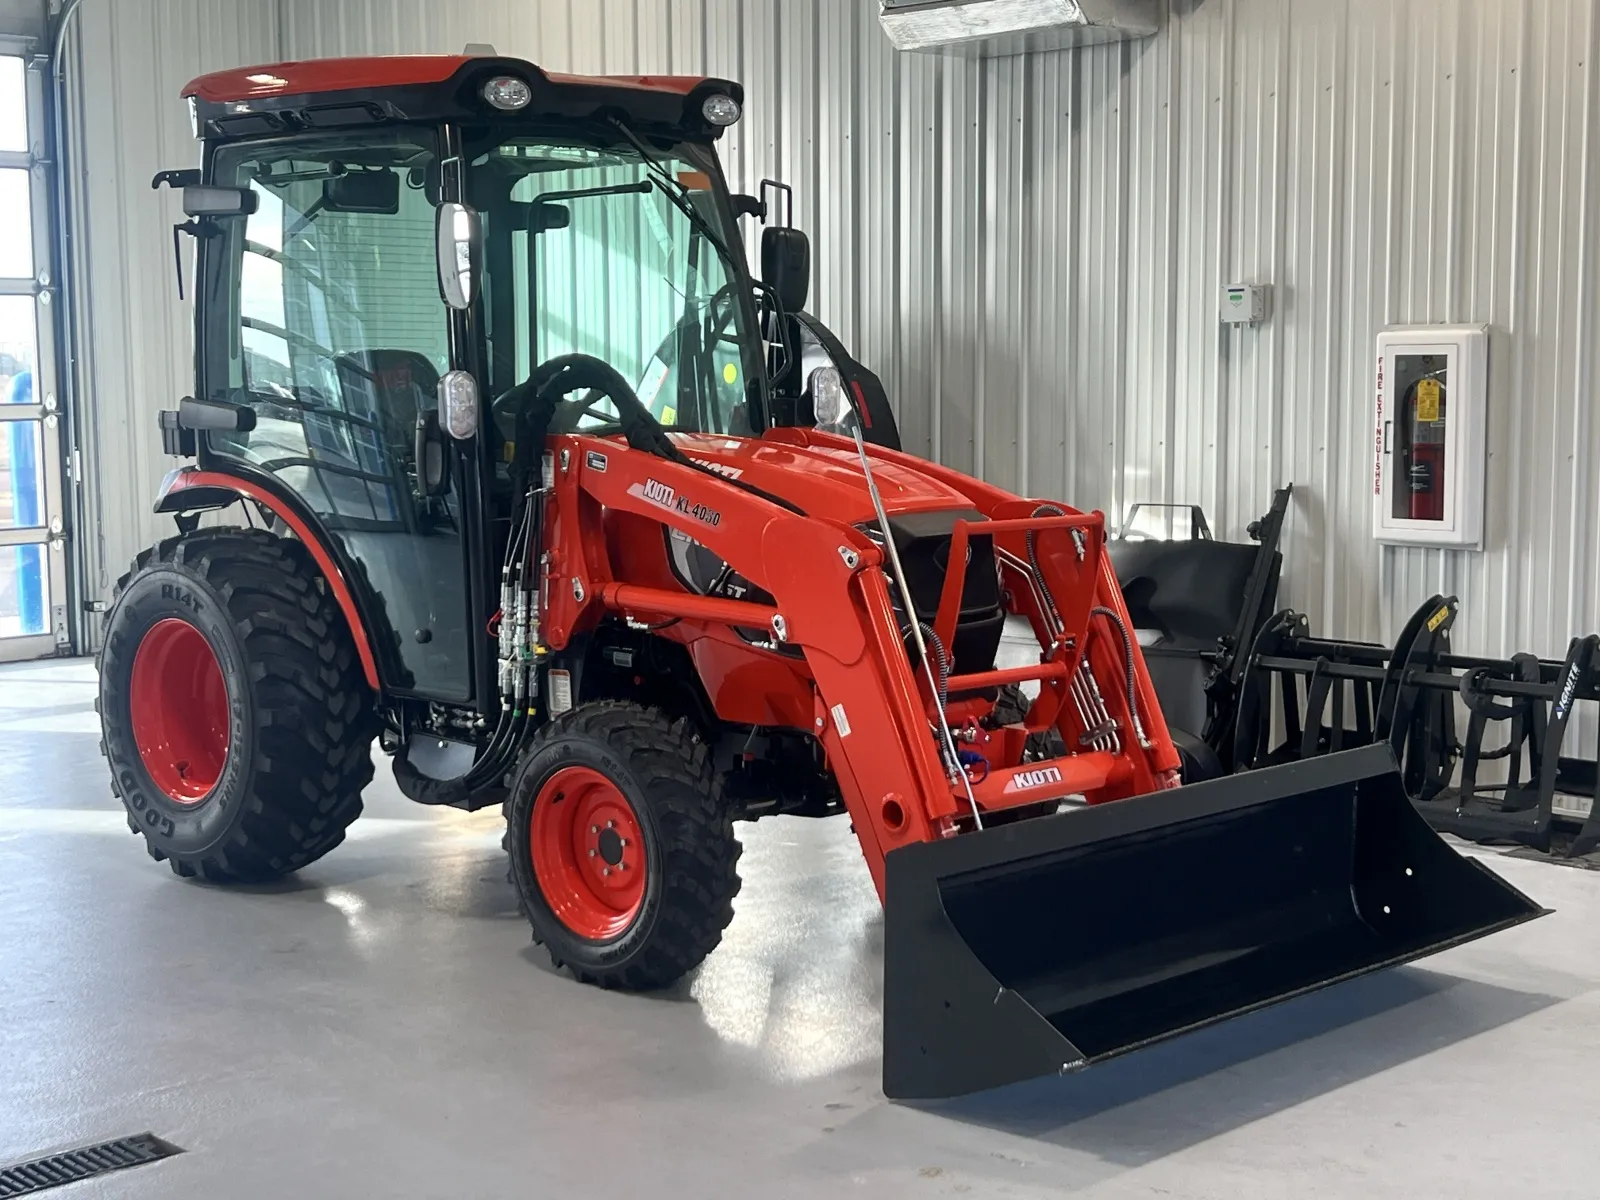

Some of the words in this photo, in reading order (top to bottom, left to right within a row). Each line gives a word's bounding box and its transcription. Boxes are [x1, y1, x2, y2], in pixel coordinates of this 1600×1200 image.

[1374, 394, 1382, 495] EXTINGUISHER
[643, 478, 675, 507] KIOTI
[161, 584, 204, 613] R14T
[1559, 662, 1578, 709] IGNITE
[1013, 766, 1062, 788] KIOTI
